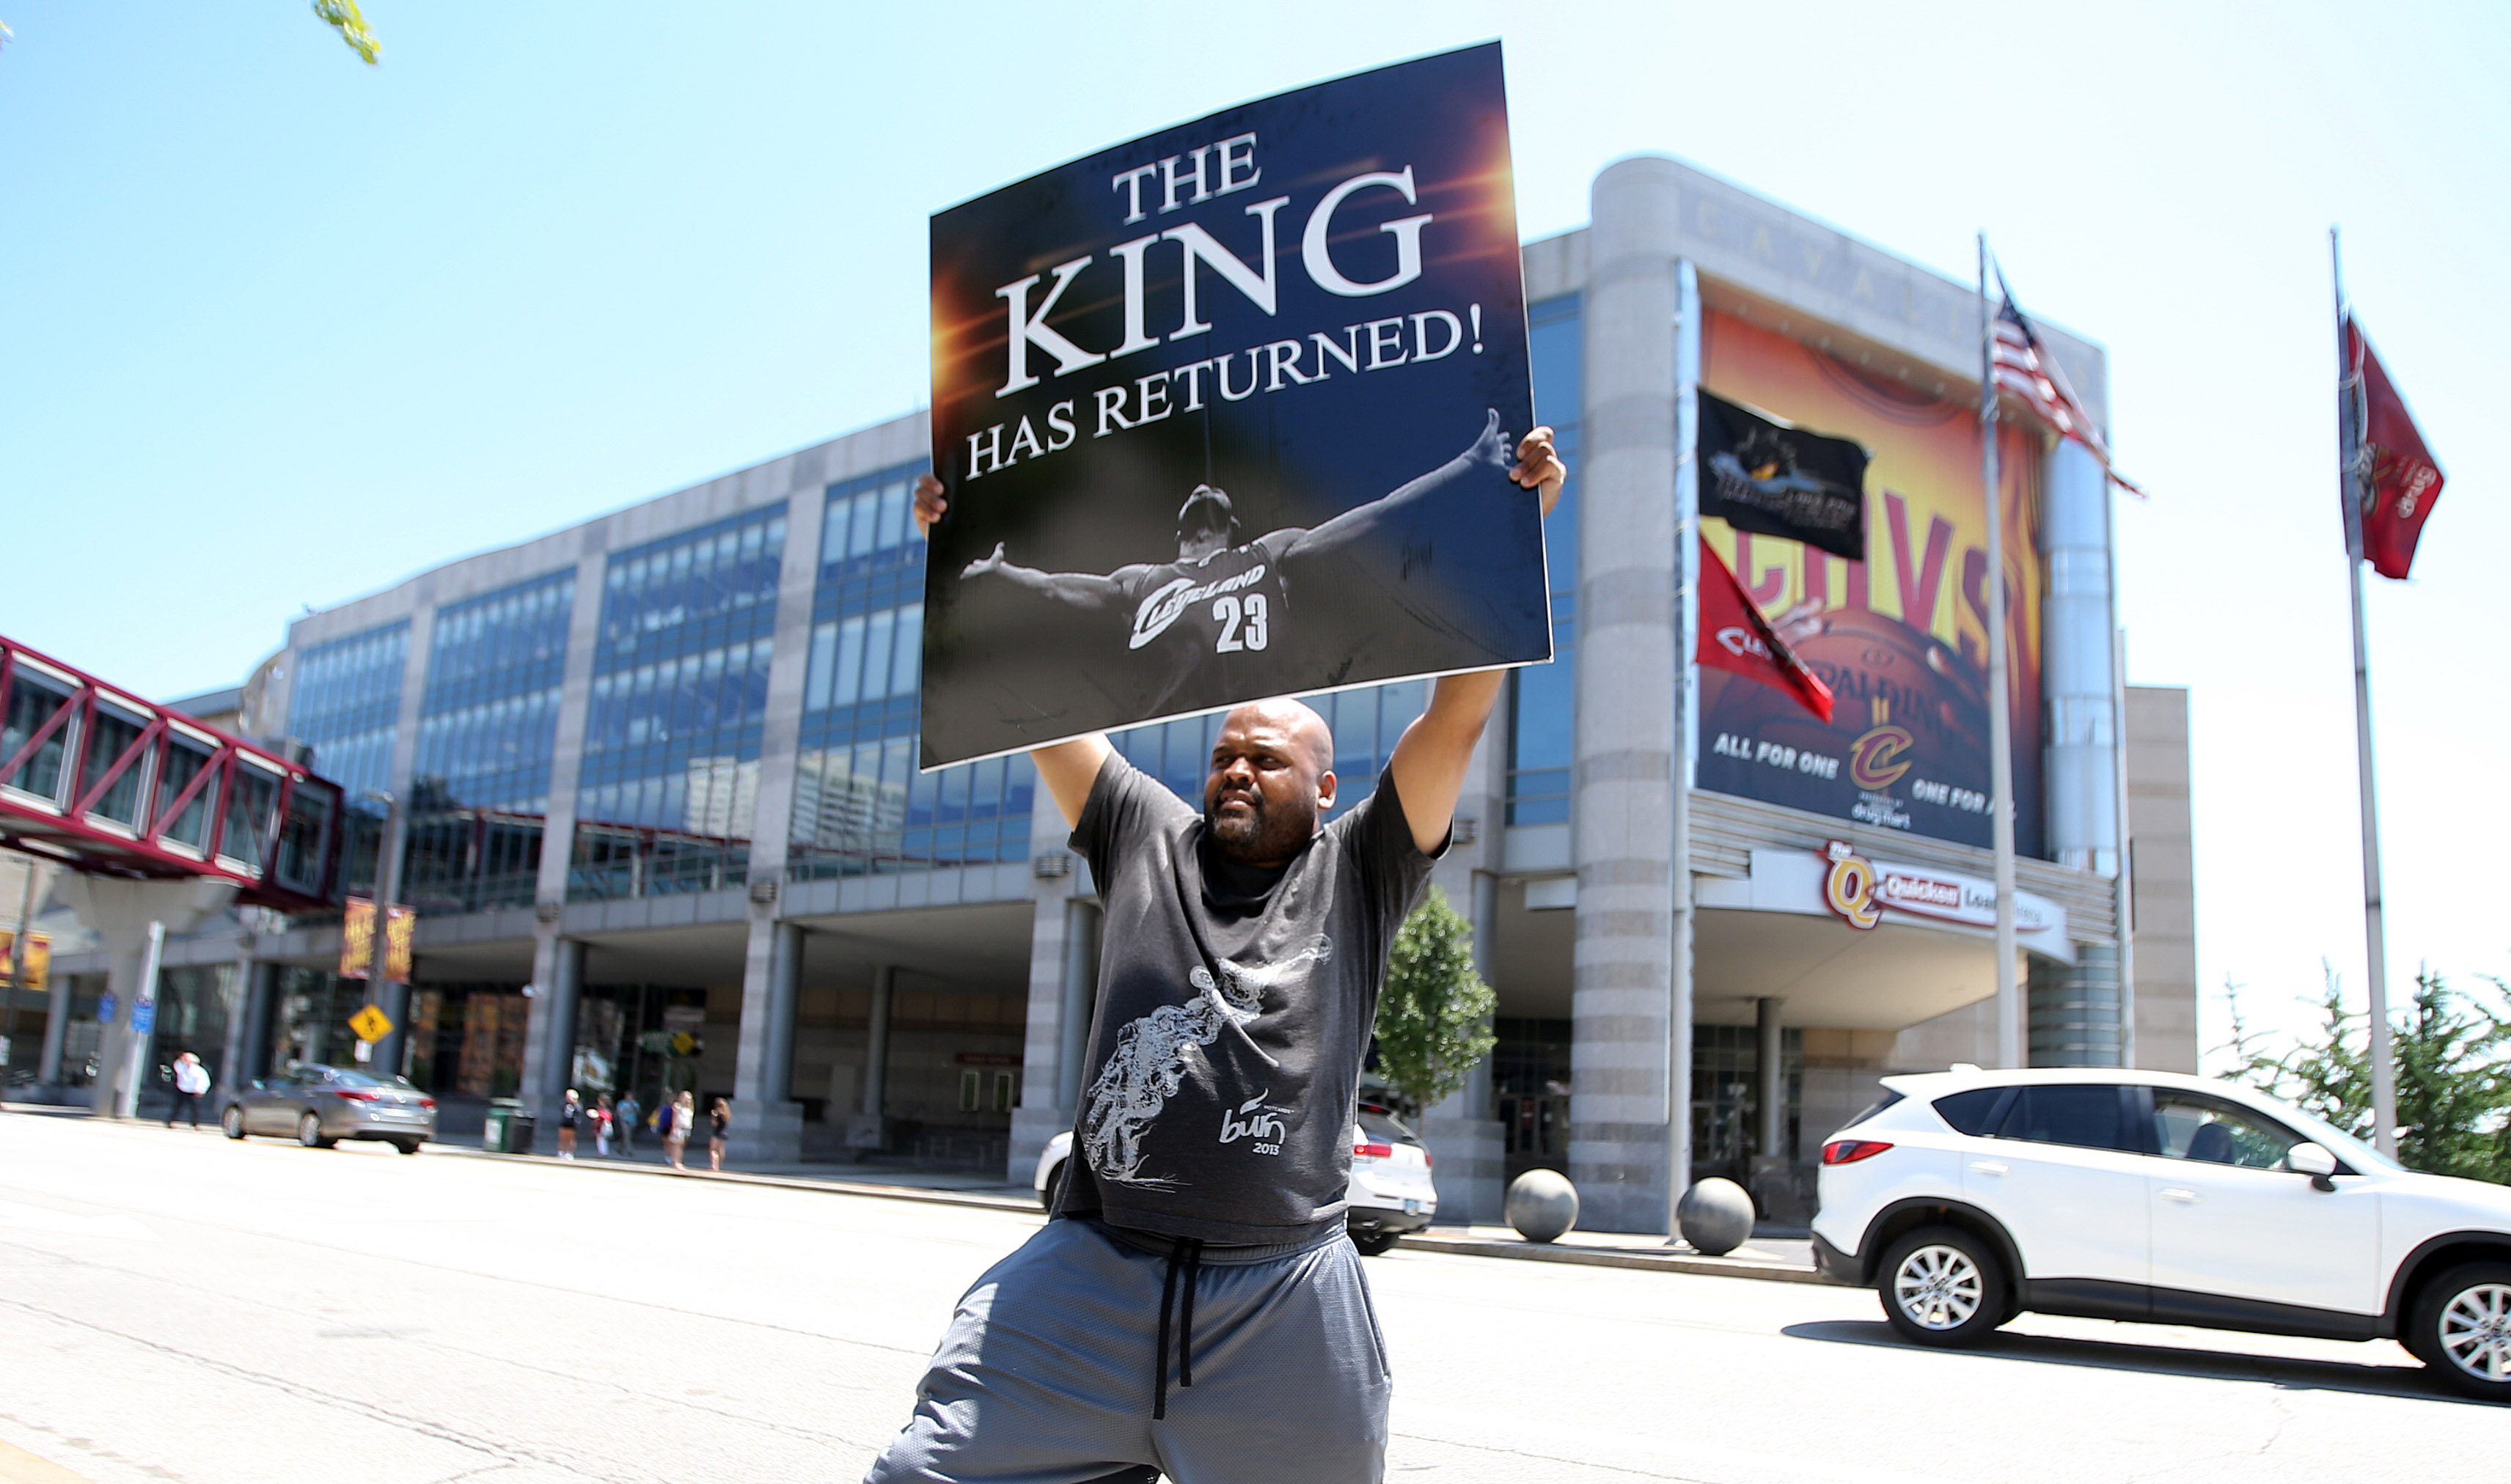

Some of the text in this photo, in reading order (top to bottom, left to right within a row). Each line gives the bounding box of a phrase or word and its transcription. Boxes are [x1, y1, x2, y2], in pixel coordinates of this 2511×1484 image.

[1112, 131, 1262, 225] THE
[994, 164, 1434, 398] KING
[1698, 198, 2089, 392] CAVALIS
[965, 303, 1485, 481] HAS RETURNED!
[1129, 564, 1267, 650] CLEVELAND
[1212, 592, 1269, 654] 23
[1713, 732, 1840, 781] ALL FOR ONE
[1911, 778, 1950, 806] ONE
[1949, 787, 1986, 815] FOR
[1828, 855, 1883, 929] Q
[1887, 876, 1958, 906] Quicken
[1218, 1108, 1286, 1145] burn
[1253, 1142, 1280, 1156] 2013
